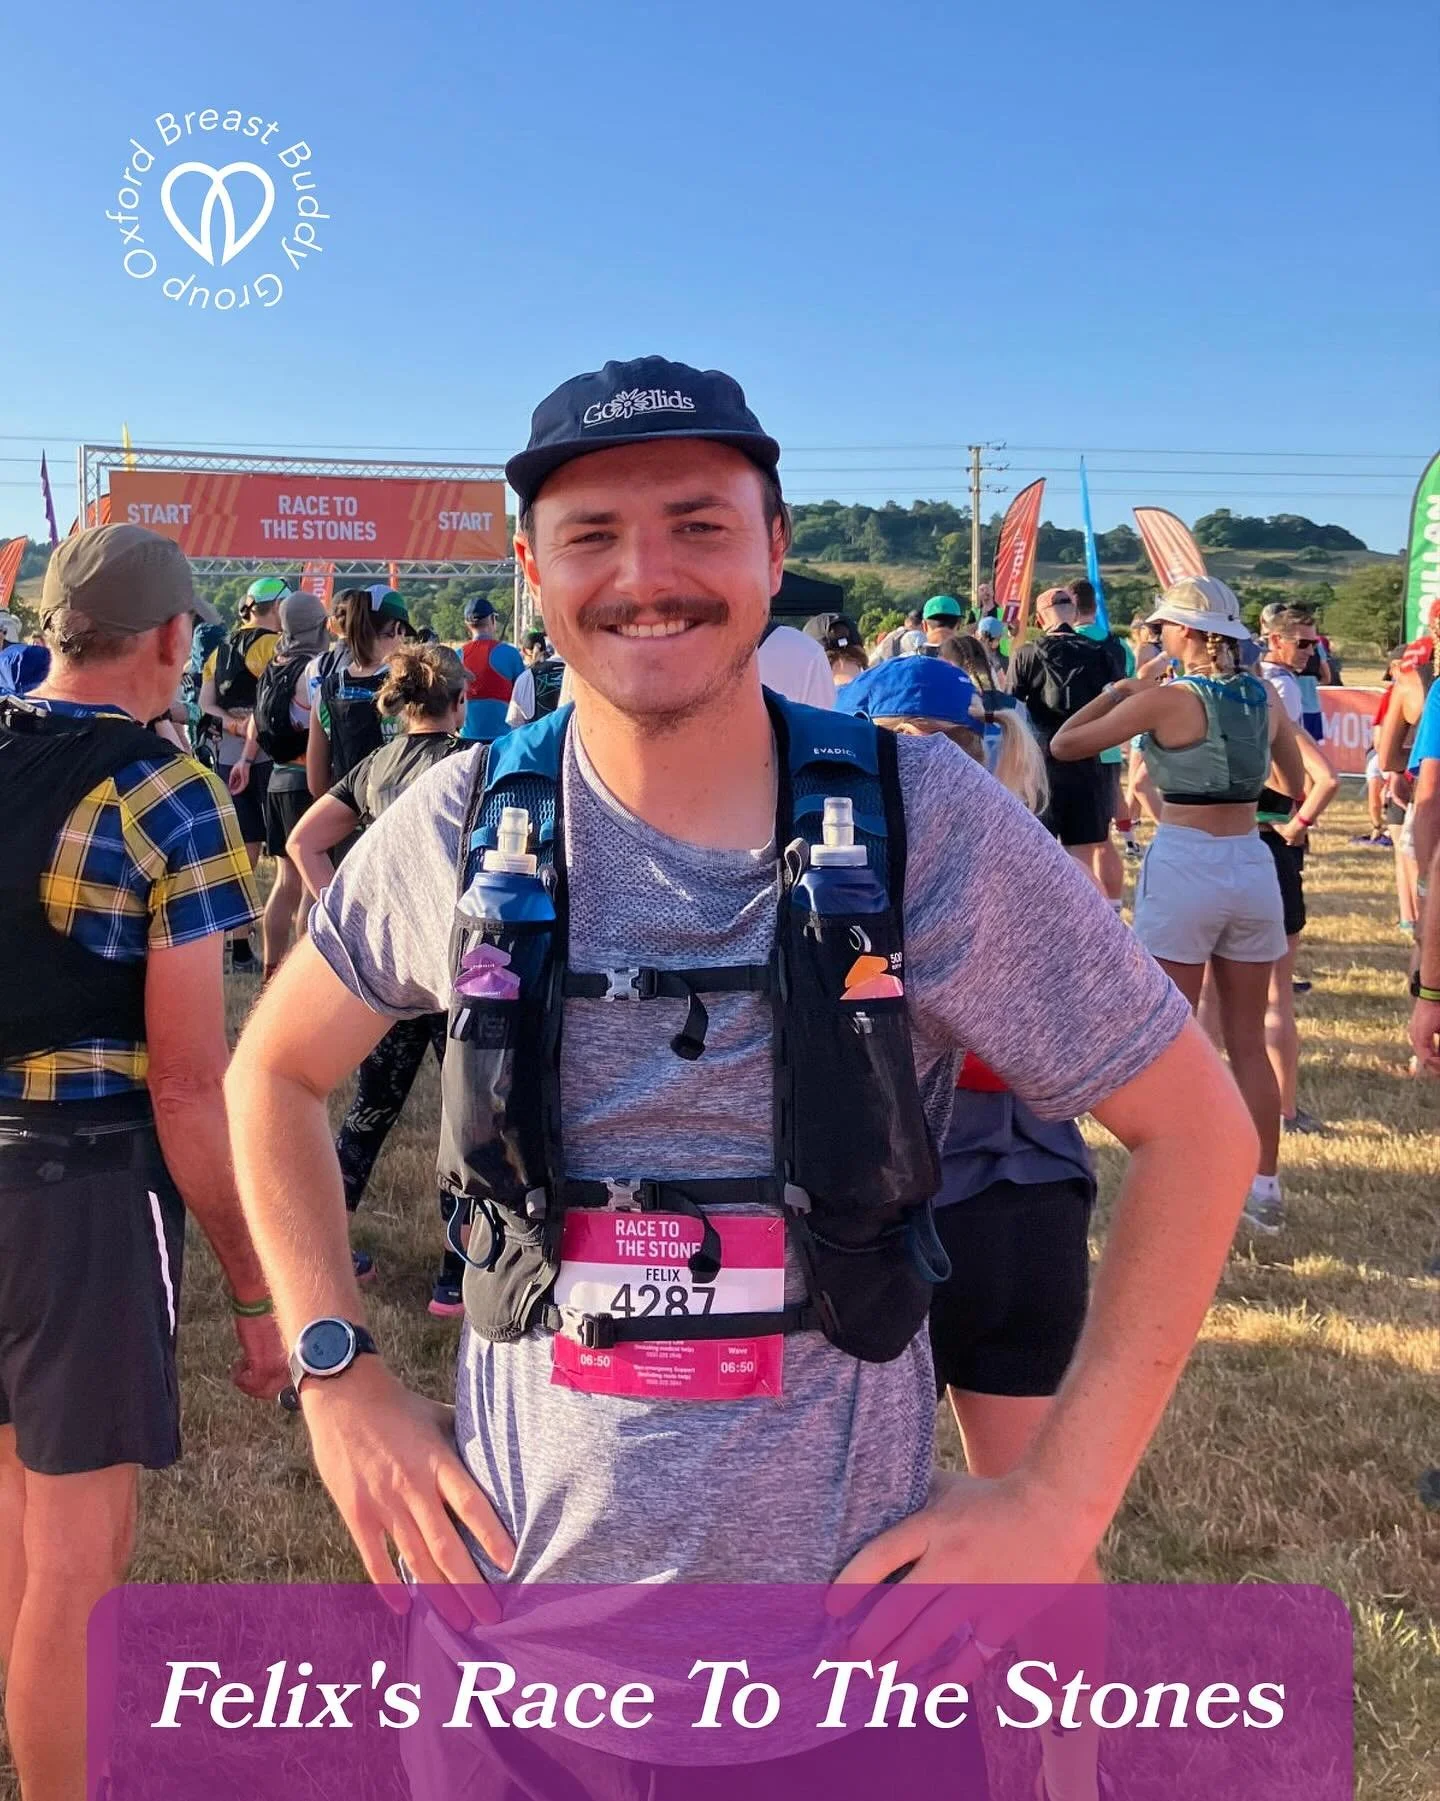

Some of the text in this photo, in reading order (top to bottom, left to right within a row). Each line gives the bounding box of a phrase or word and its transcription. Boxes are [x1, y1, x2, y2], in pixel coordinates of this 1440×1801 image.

[127, 503, 192, 525] START
[278, 495, 358, 517] RACE TO
[261, 519, 376, 541] THE STONES
[438, 511, 493, 531] START
[615, 1219, 680, 1238] RACE TO
[616, 1239, 701, 1259] THE STONE
[646, 1268, 681, 1282] FELIX
[610, 1283, 716, 1317] 4287
[580, 1353, 611, 1368] 06:50
[720, 1360, 754, 1374] 06:50
